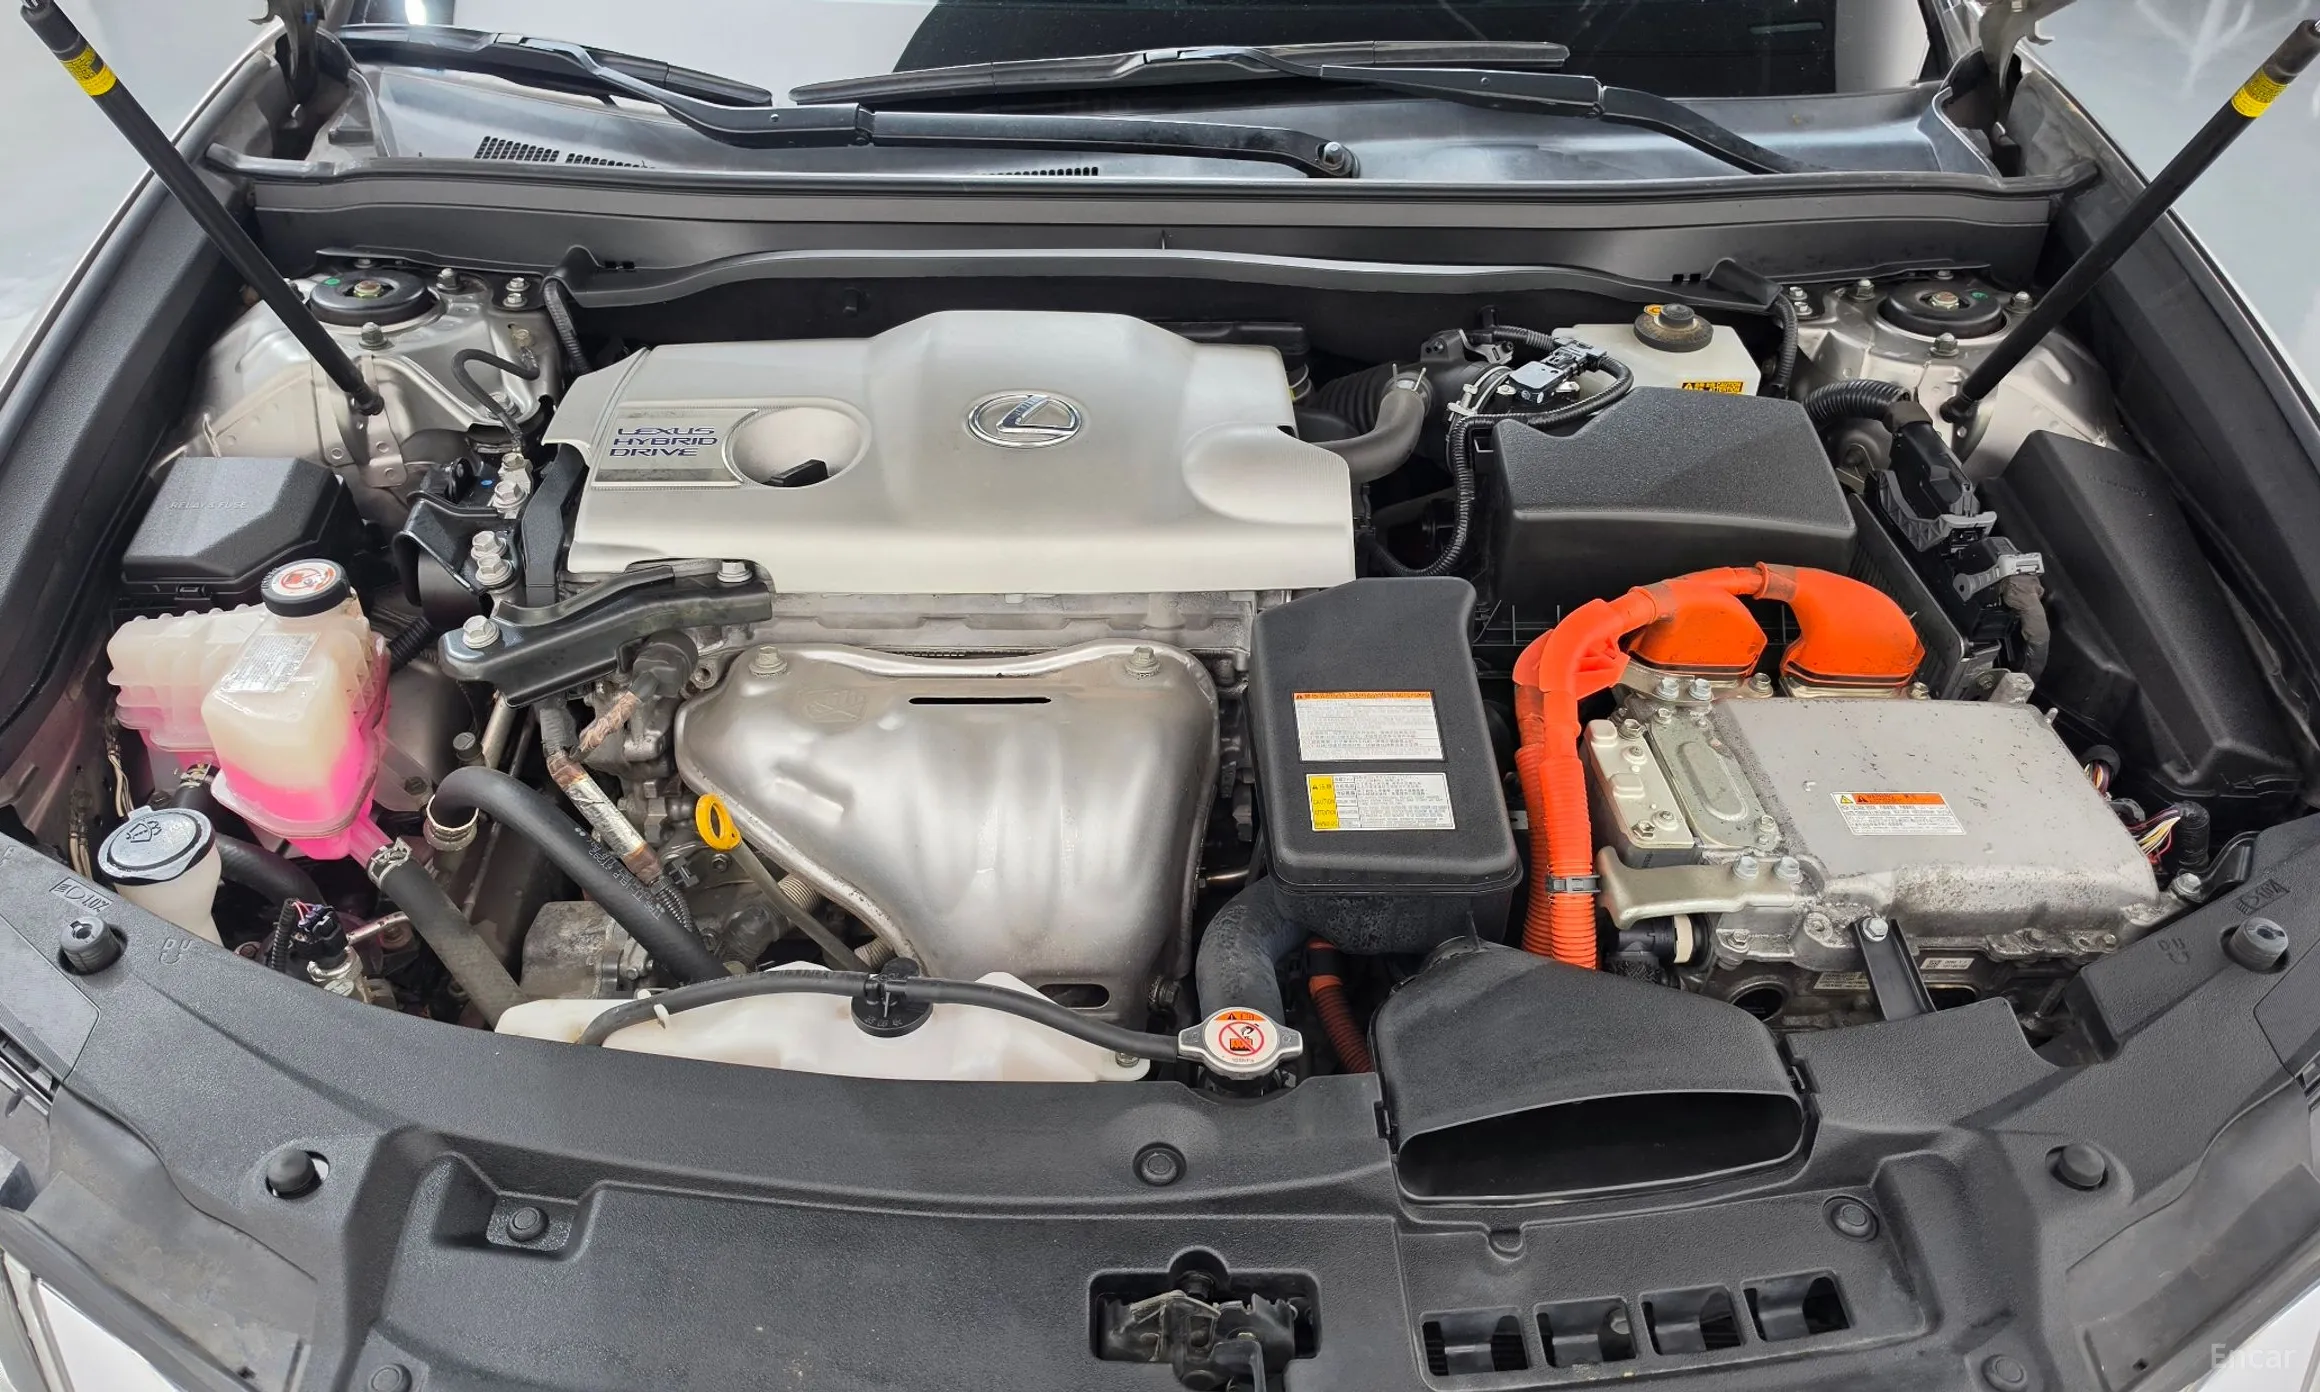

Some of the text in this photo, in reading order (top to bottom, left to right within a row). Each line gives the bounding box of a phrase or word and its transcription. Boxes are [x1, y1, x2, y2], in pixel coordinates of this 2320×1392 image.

[609, 448, 698, 456] DRIVE
[169, 501, 206, 510] RELAY
[218, 501, 248, 510] FUSE
